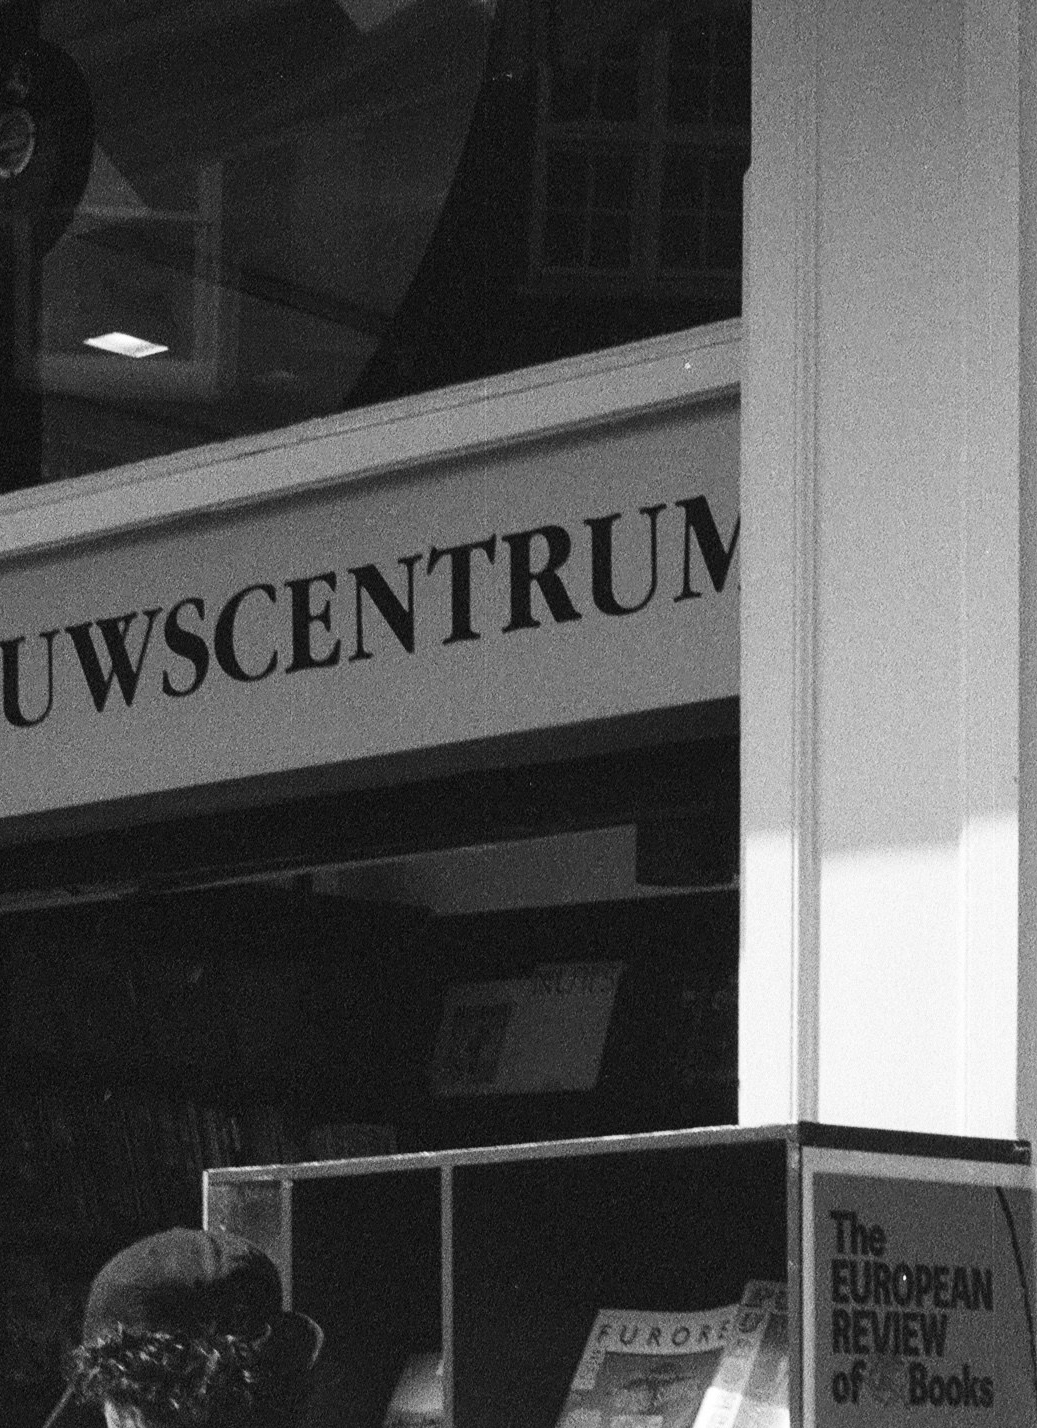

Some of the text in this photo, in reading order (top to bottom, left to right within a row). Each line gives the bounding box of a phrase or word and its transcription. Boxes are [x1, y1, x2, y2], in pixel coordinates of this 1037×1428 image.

[829, 1209, 887, 1257] The
[830, 1258, 994, 1312] EUROPEAN
[831, 1307, 948, 1358] REVIEW
[832, 1359, 994, 1408] of Books
